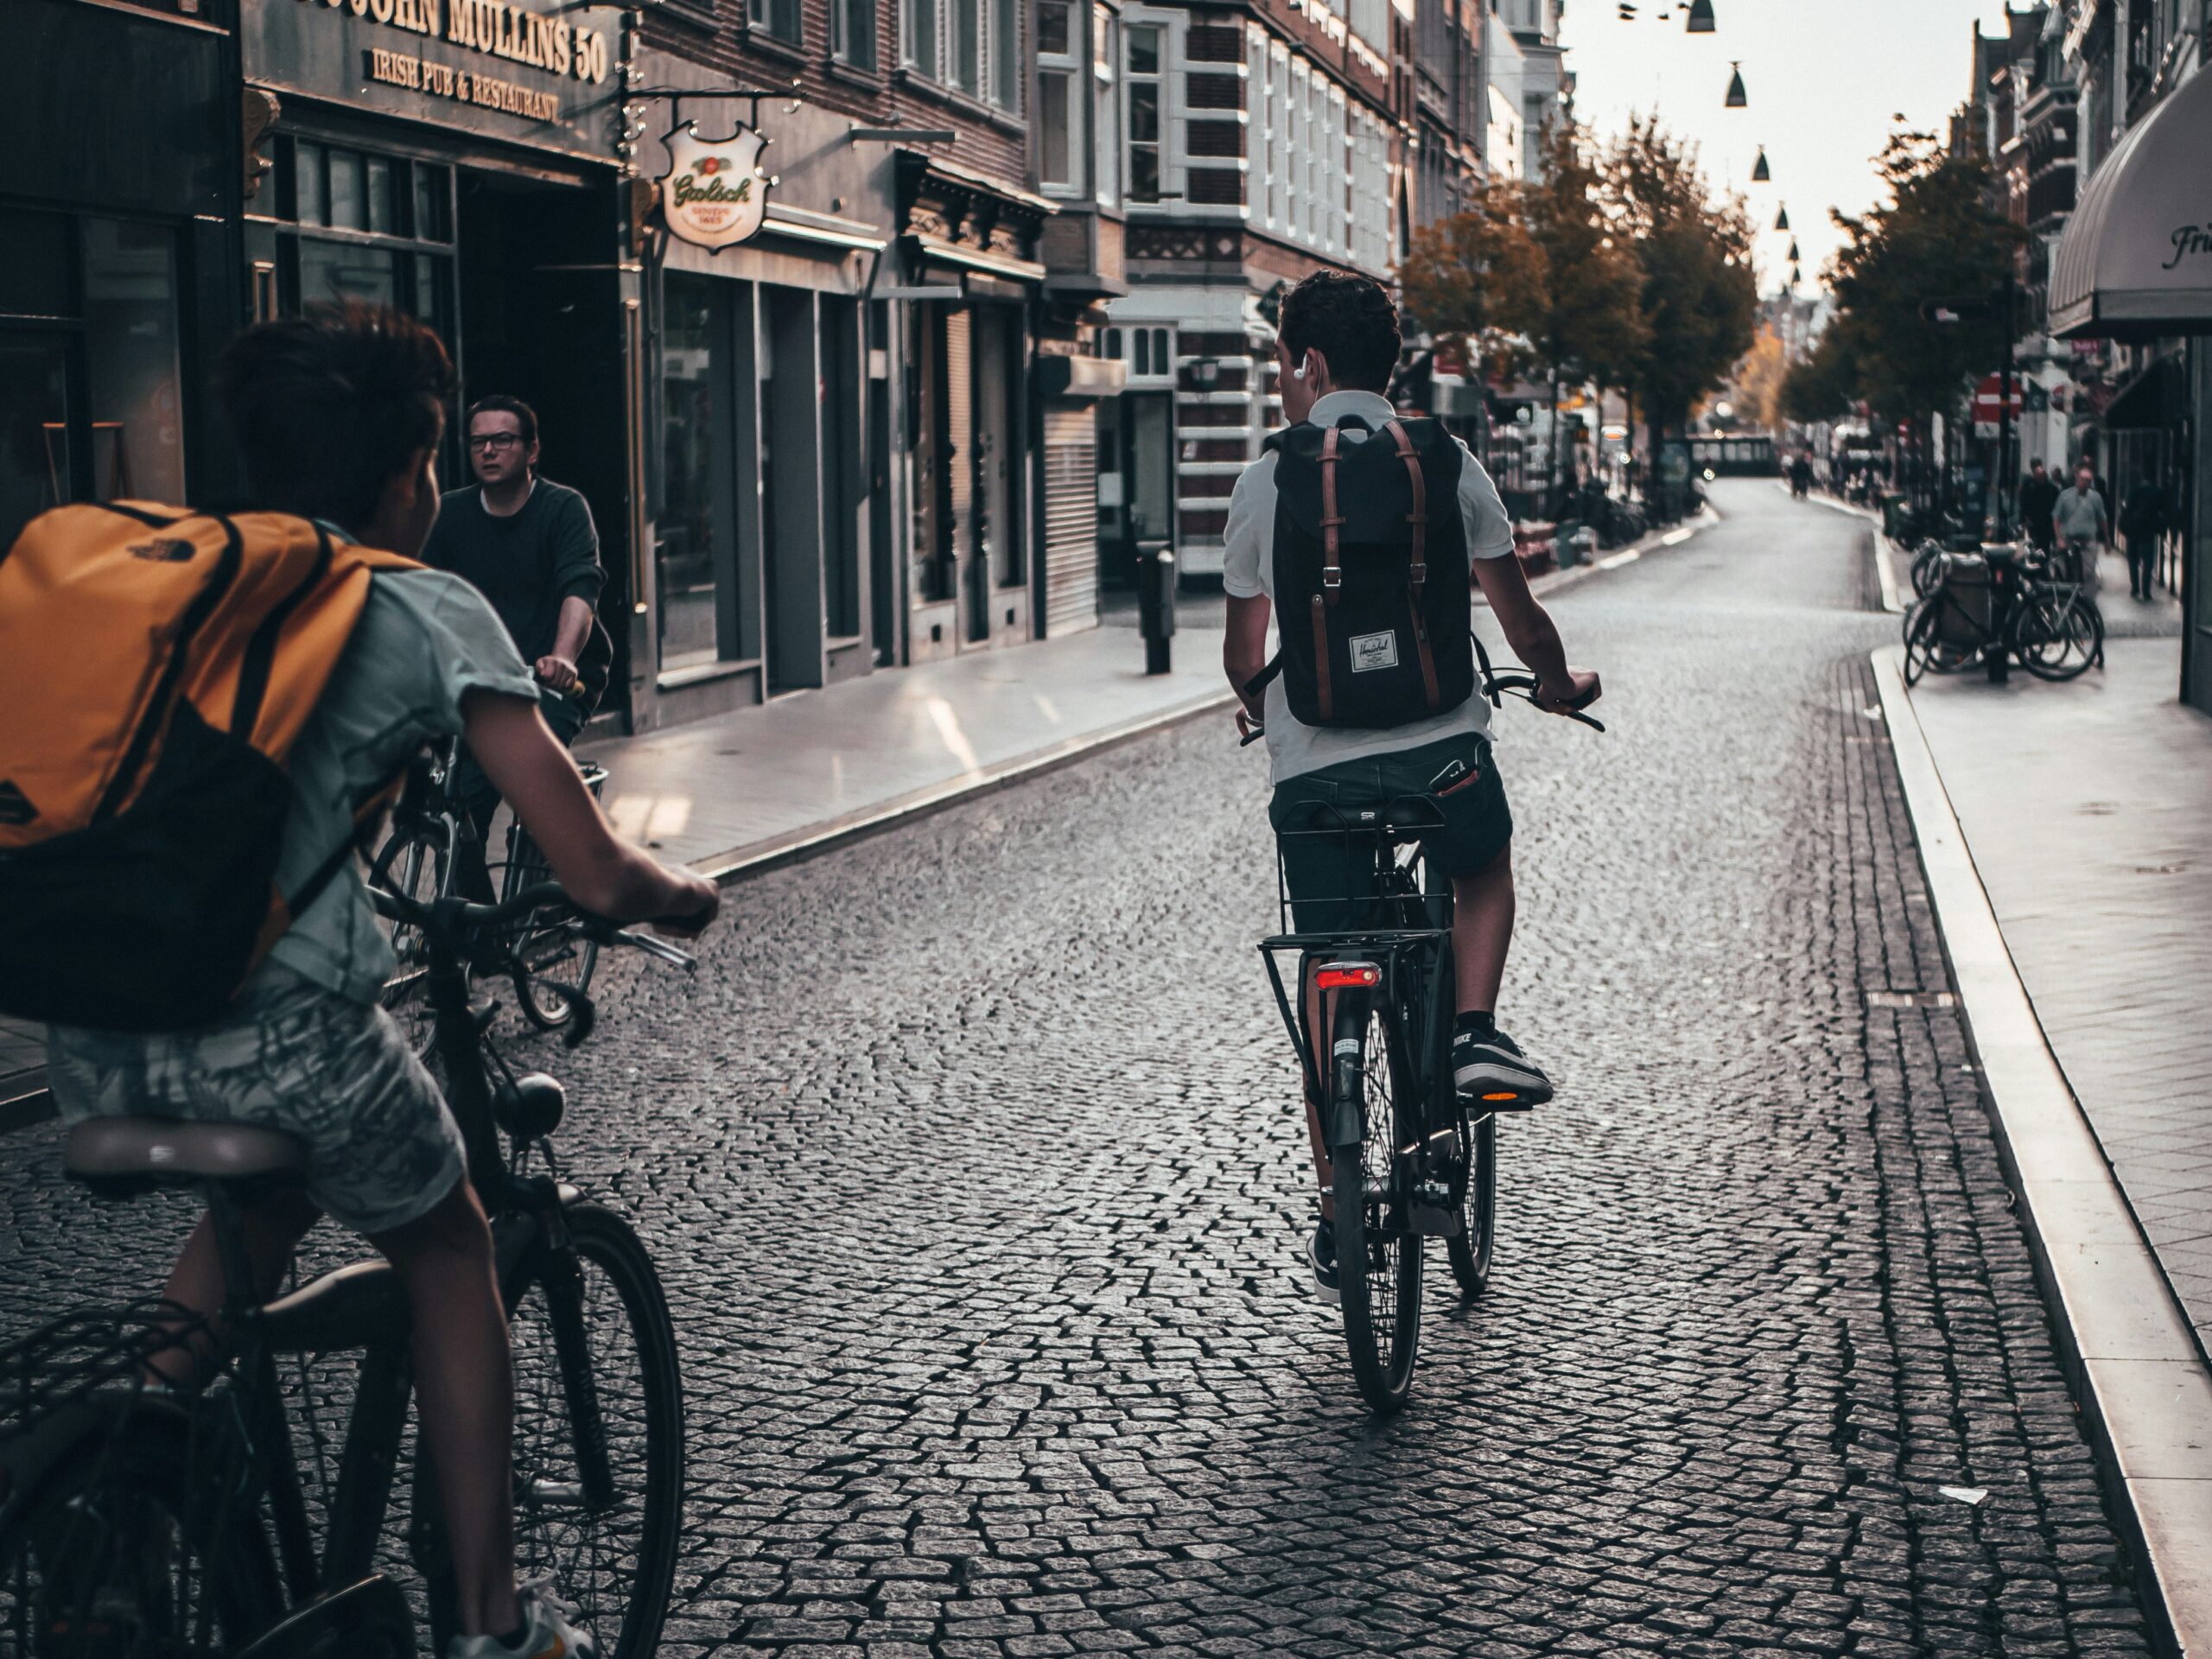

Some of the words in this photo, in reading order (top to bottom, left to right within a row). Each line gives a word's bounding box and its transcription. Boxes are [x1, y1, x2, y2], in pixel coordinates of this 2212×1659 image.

[448, 0, 571, 75] MULLINS
[575, 26, 607, 85] 50
[372, 48, 420, 89] IRISH
[422, 60, 454, 97] PUB
[456, 69, 469, 101] &
[471, 74, 560, 124] RESTAURANT
[672, 174, 751, 208] Grolsch
[2162, 222, 2212, 270] Fri
[1453, 1033, 1472, 1047] NIKE
